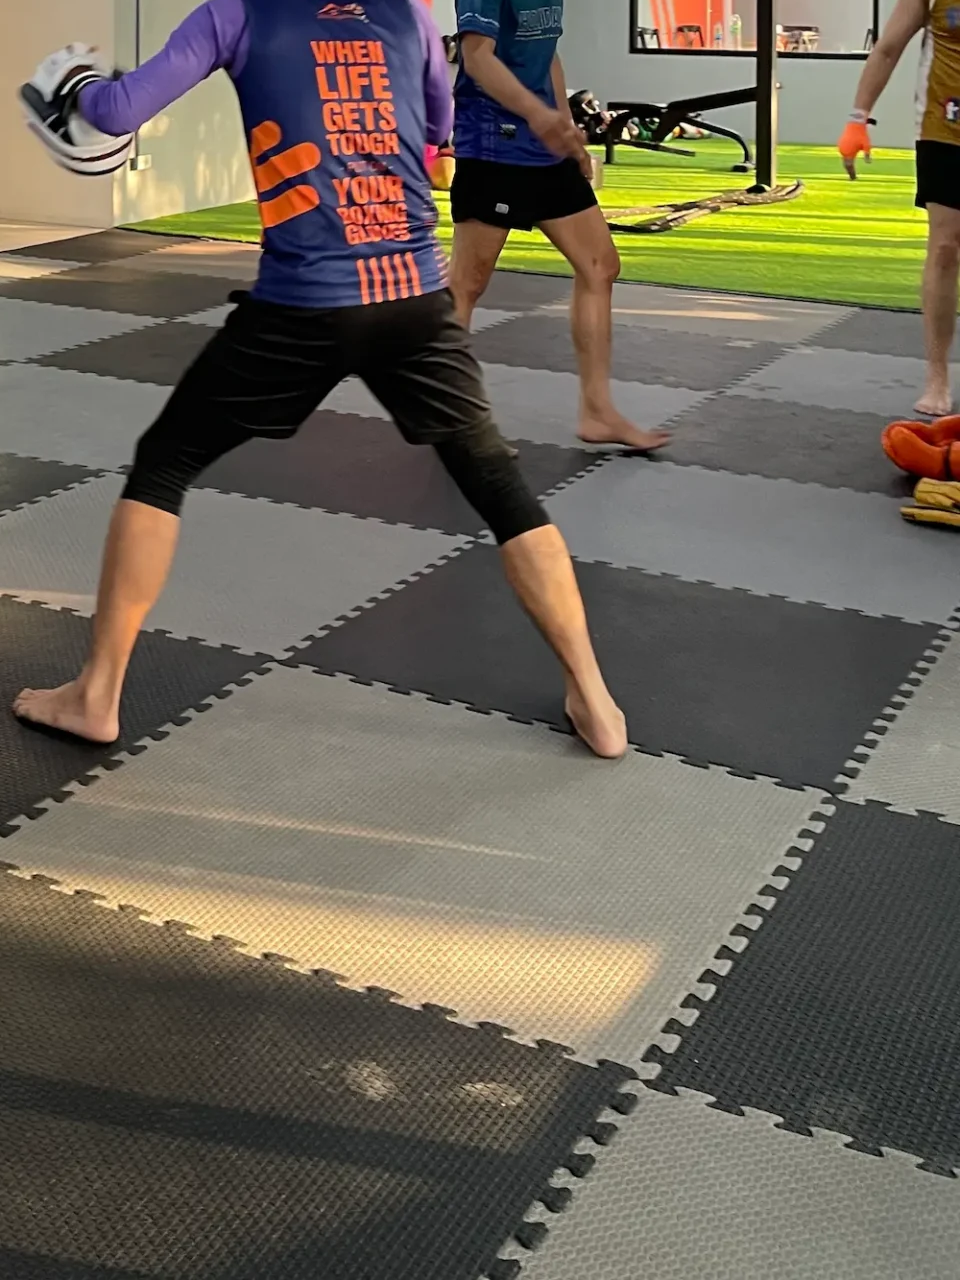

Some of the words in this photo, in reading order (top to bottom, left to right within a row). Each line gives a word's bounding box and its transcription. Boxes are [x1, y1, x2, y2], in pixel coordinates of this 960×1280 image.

[310, 40, 385, 64] WHEN
[315, 66, 393, 100] LIFE
[322, 101, 398, 132] GETS
[325, 133, 401, 157] TOUGH
[332, 176, 406, 206] YOUR
